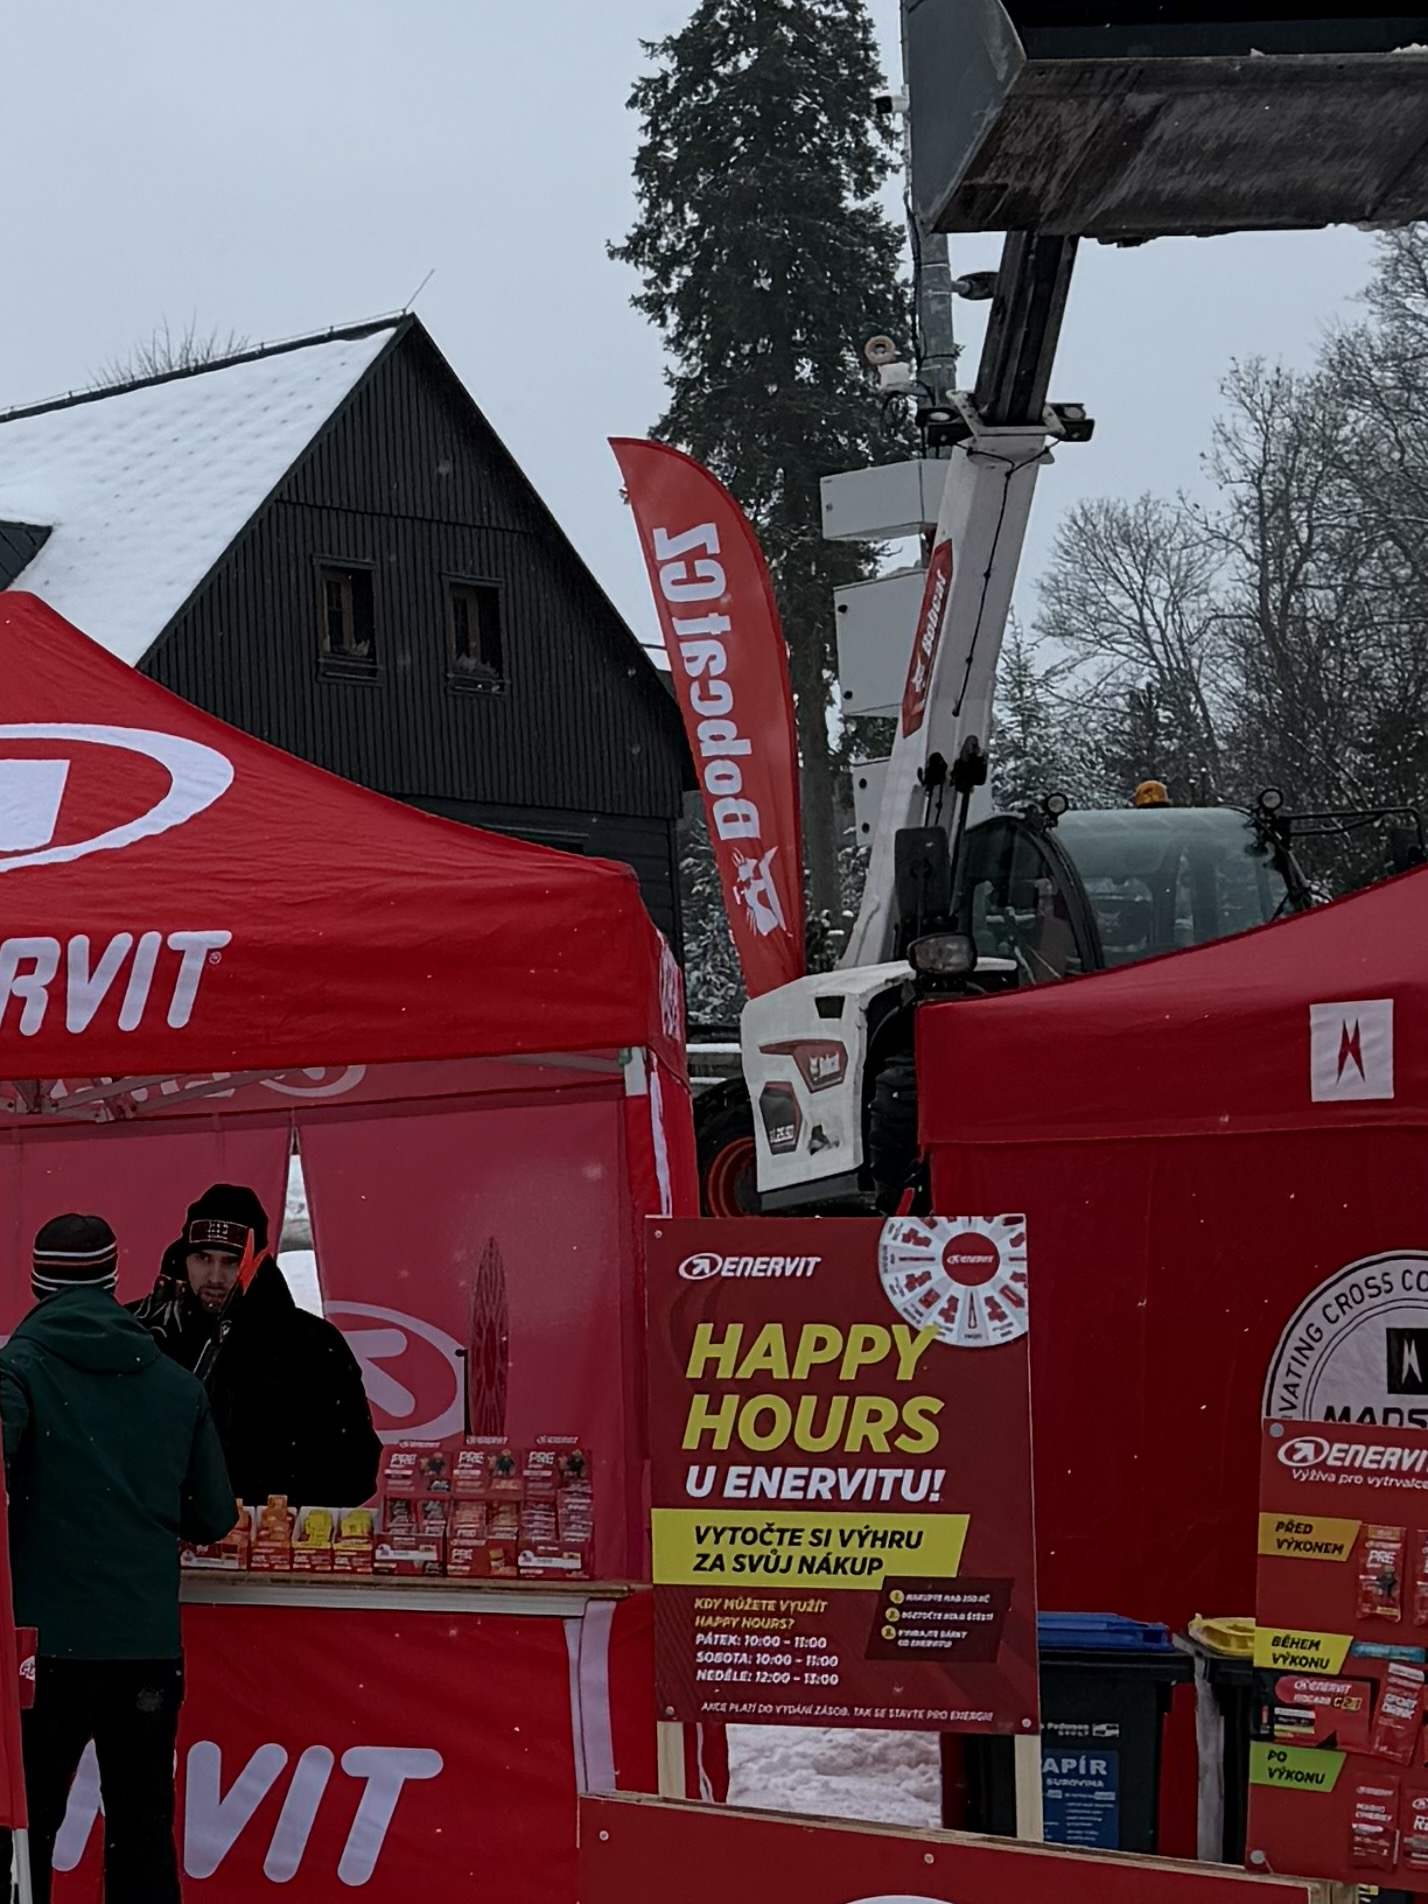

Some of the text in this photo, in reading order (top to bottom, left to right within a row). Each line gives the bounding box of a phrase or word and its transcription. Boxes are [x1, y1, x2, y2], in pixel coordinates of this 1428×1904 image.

[721, 1256, 821, 1278] ENERVIT
[686, 1323, 938, 1381] HAPPY
[1278, 1322, 1324, 1417] VATING
[1322, 1272, 1394, 1325] CROSS
[682, 1394, 945, 1453] HOURS
[1327, 1443, 1428, 1473] ENERVI
[686, 1466, 945, 1502] U ENERVITU!
[1338, 1474, 1364, 1485] pro
[695, 1523, 924, 1550] VYTOČTE SI VÝHRU
[1275, 1519, 1314, 1535] PŘED
[693, 1549, 884, 1576] ZA SVŮJ NÁKUP
[695, 1598, 722, 1610] KDY
[695, 1616, 795, 1629] HAPPY HOURS?
[696, 1631, 741, 1645] PÁTEK:
[744, 1634, 780, 1646] 10:00
[794, 1636, 827, 1648] 11:00
[696, 1651, 752, 1664] SOBOTA:
[756, 1653, 792, 1665] 10:00
[806, 1655, 839, 1667] 11:00
[1272, 1652, 1330, 1670] VÝKONU
[755, 1671, 790, 1684] 12:00
[1042, 1755, 1107, 1775] APÍR
[1267, 1749, 1287, 1762] PO
[1268, 1766, 1325, 1785] VÝKONU
